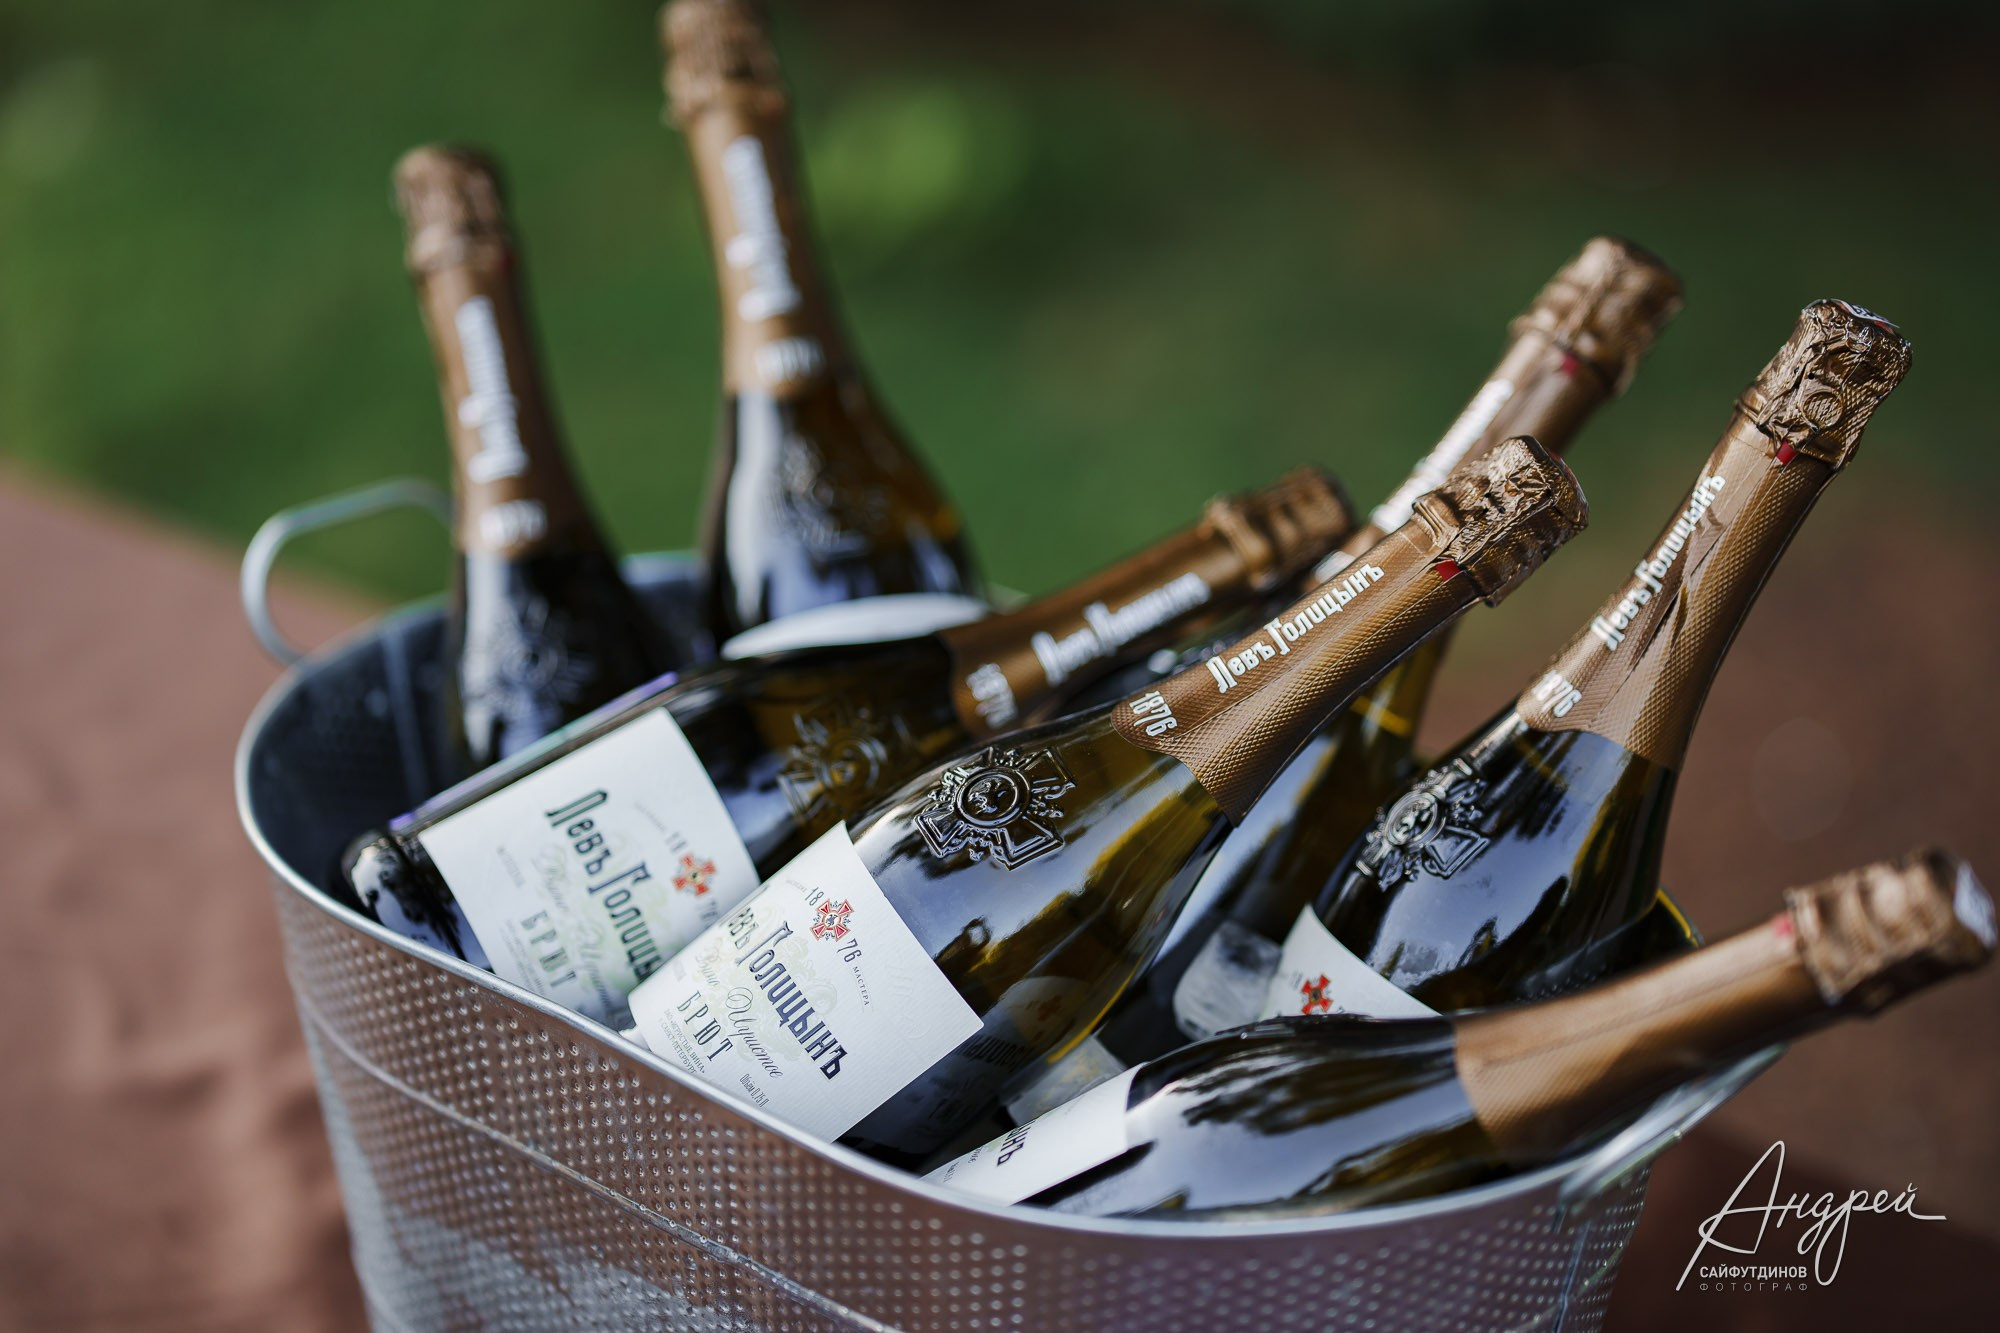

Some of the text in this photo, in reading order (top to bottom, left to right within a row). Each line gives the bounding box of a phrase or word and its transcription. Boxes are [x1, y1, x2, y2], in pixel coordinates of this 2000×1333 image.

[1205, 641, 1275, 693] Левъ
[1264, 563, 1385, 655] Голицынъ
[1590, 589, 1651, 650] Левъ
[1129, 691, 1178, 737] 1876
[545, 789, 611, 876] Левъ
[804, 886, 871, 1006] 18 76 МАСТЕРА
[677, 990, 733, 1061] БРЮТ
[736, 920, 848, 1081] Голицынъ
